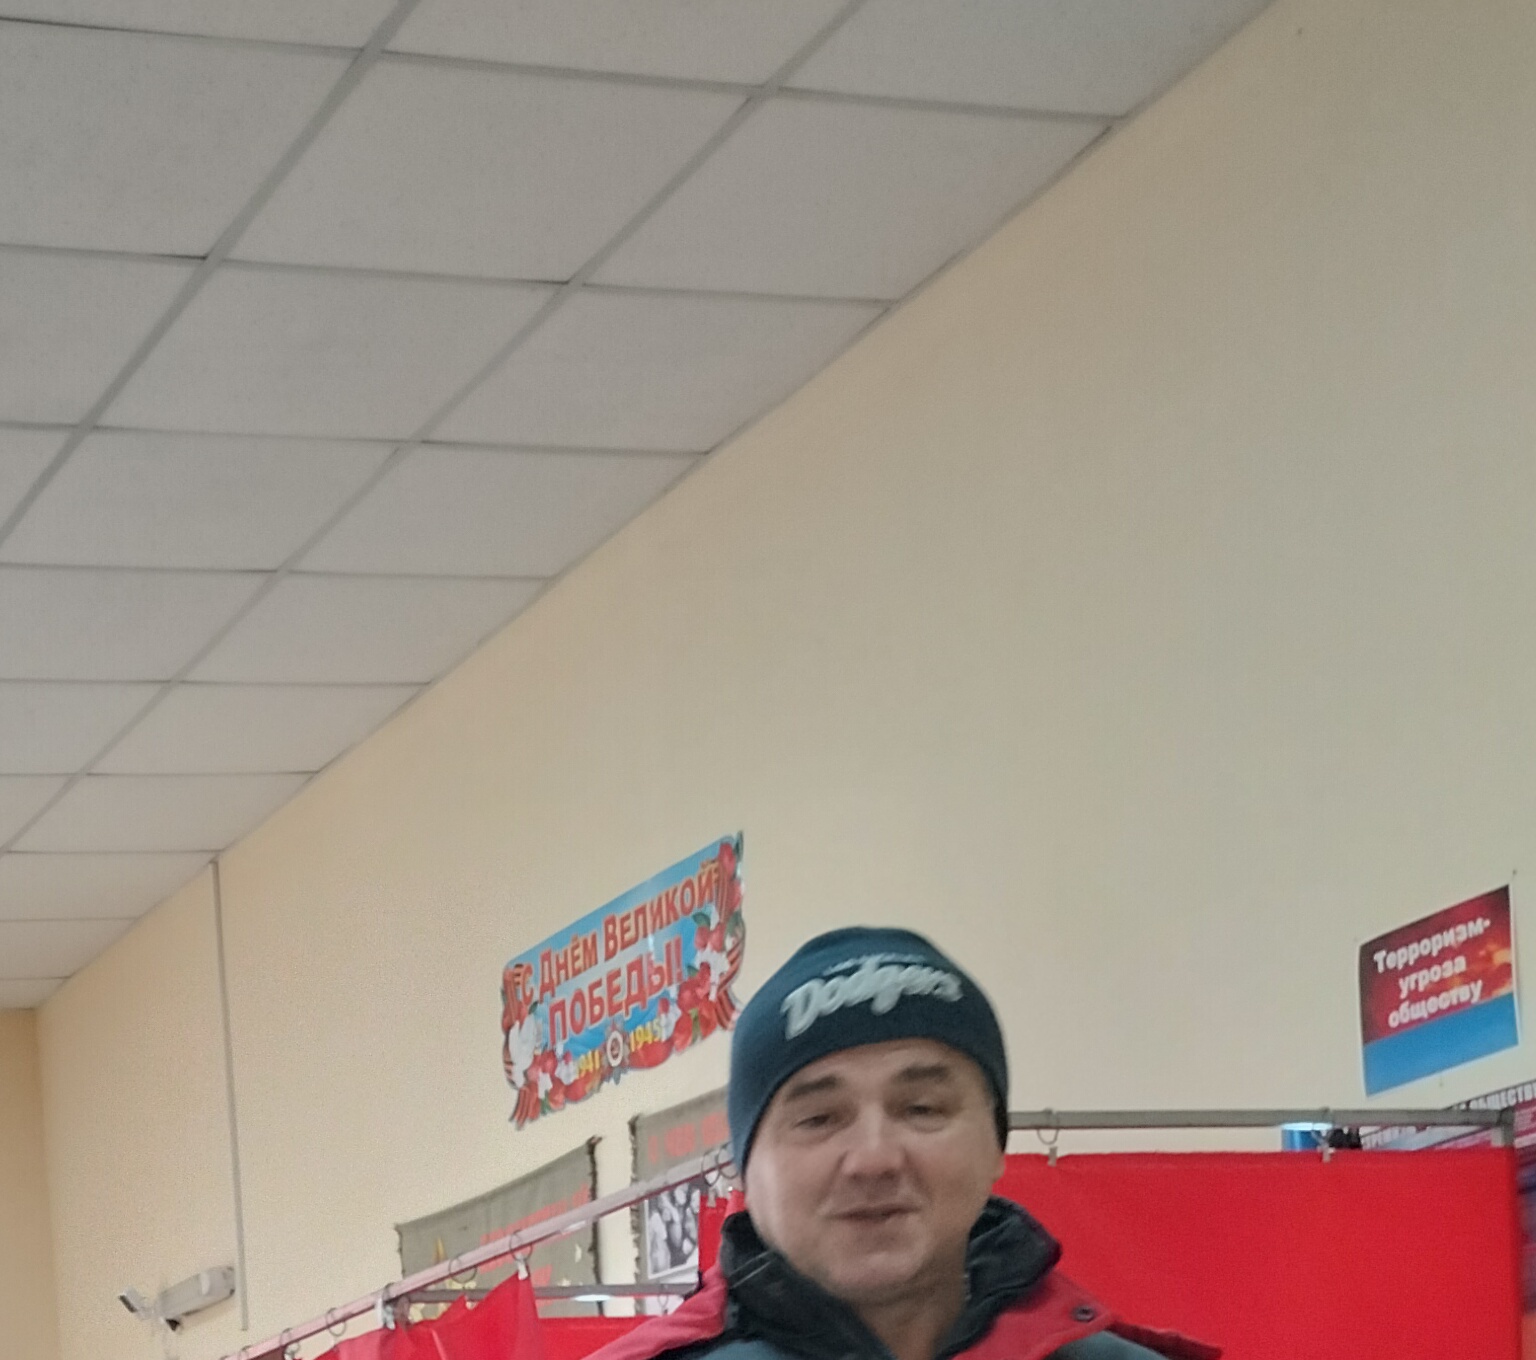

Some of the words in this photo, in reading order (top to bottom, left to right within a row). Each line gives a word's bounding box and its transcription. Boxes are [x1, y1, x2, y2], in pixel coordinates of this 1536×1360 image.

[522, 962, 534, 1006] С
[539, 930, 599, 1003] ДНЁМ
[603, 862, 718, 962] ВЕЛИКОЙ
[548, 936, 683, 1047] ПОБЕДЫ!
[1399, 955, 1467, 999] угроза
[1388, 979, 1483, 1028] обществу
[629, 1016, 663, 1052] 1945
